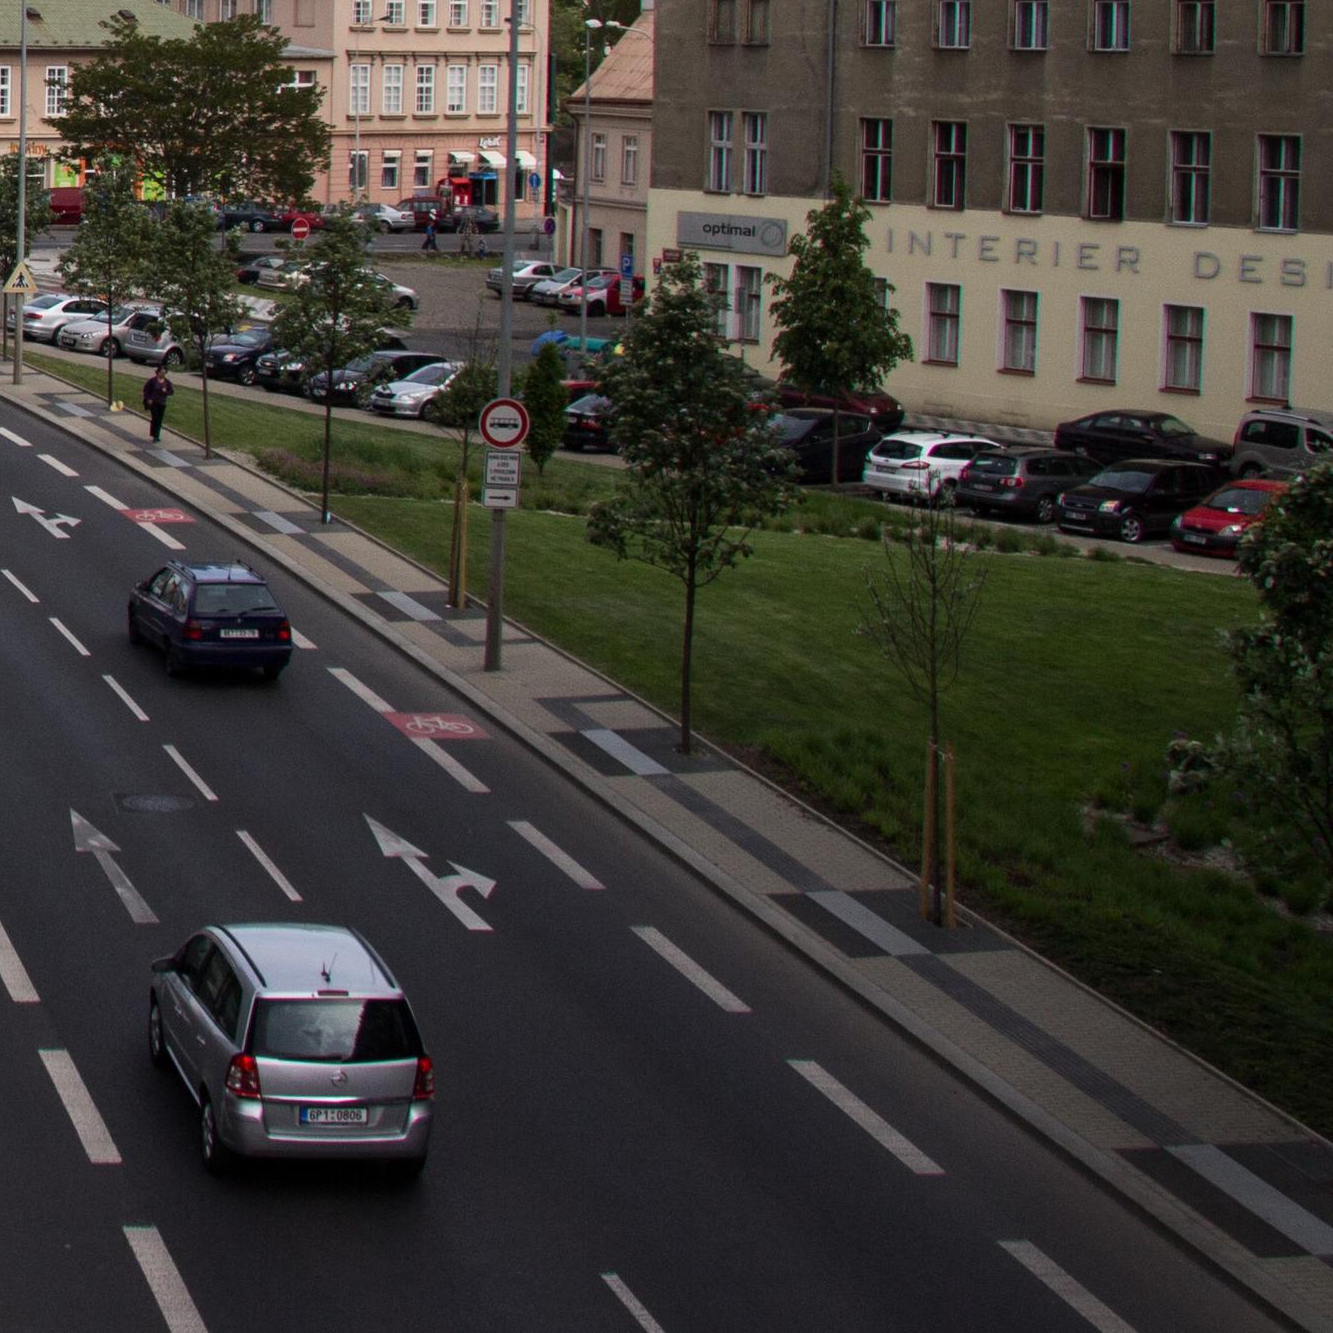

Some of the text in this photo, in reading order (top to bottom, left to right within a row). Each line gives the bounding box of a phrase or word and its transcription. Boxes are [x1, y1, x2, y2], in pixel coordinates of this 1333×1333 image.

[702, 222, 756, 237] optimal
[886, 228, 1333, 290] INTERIER DESI
